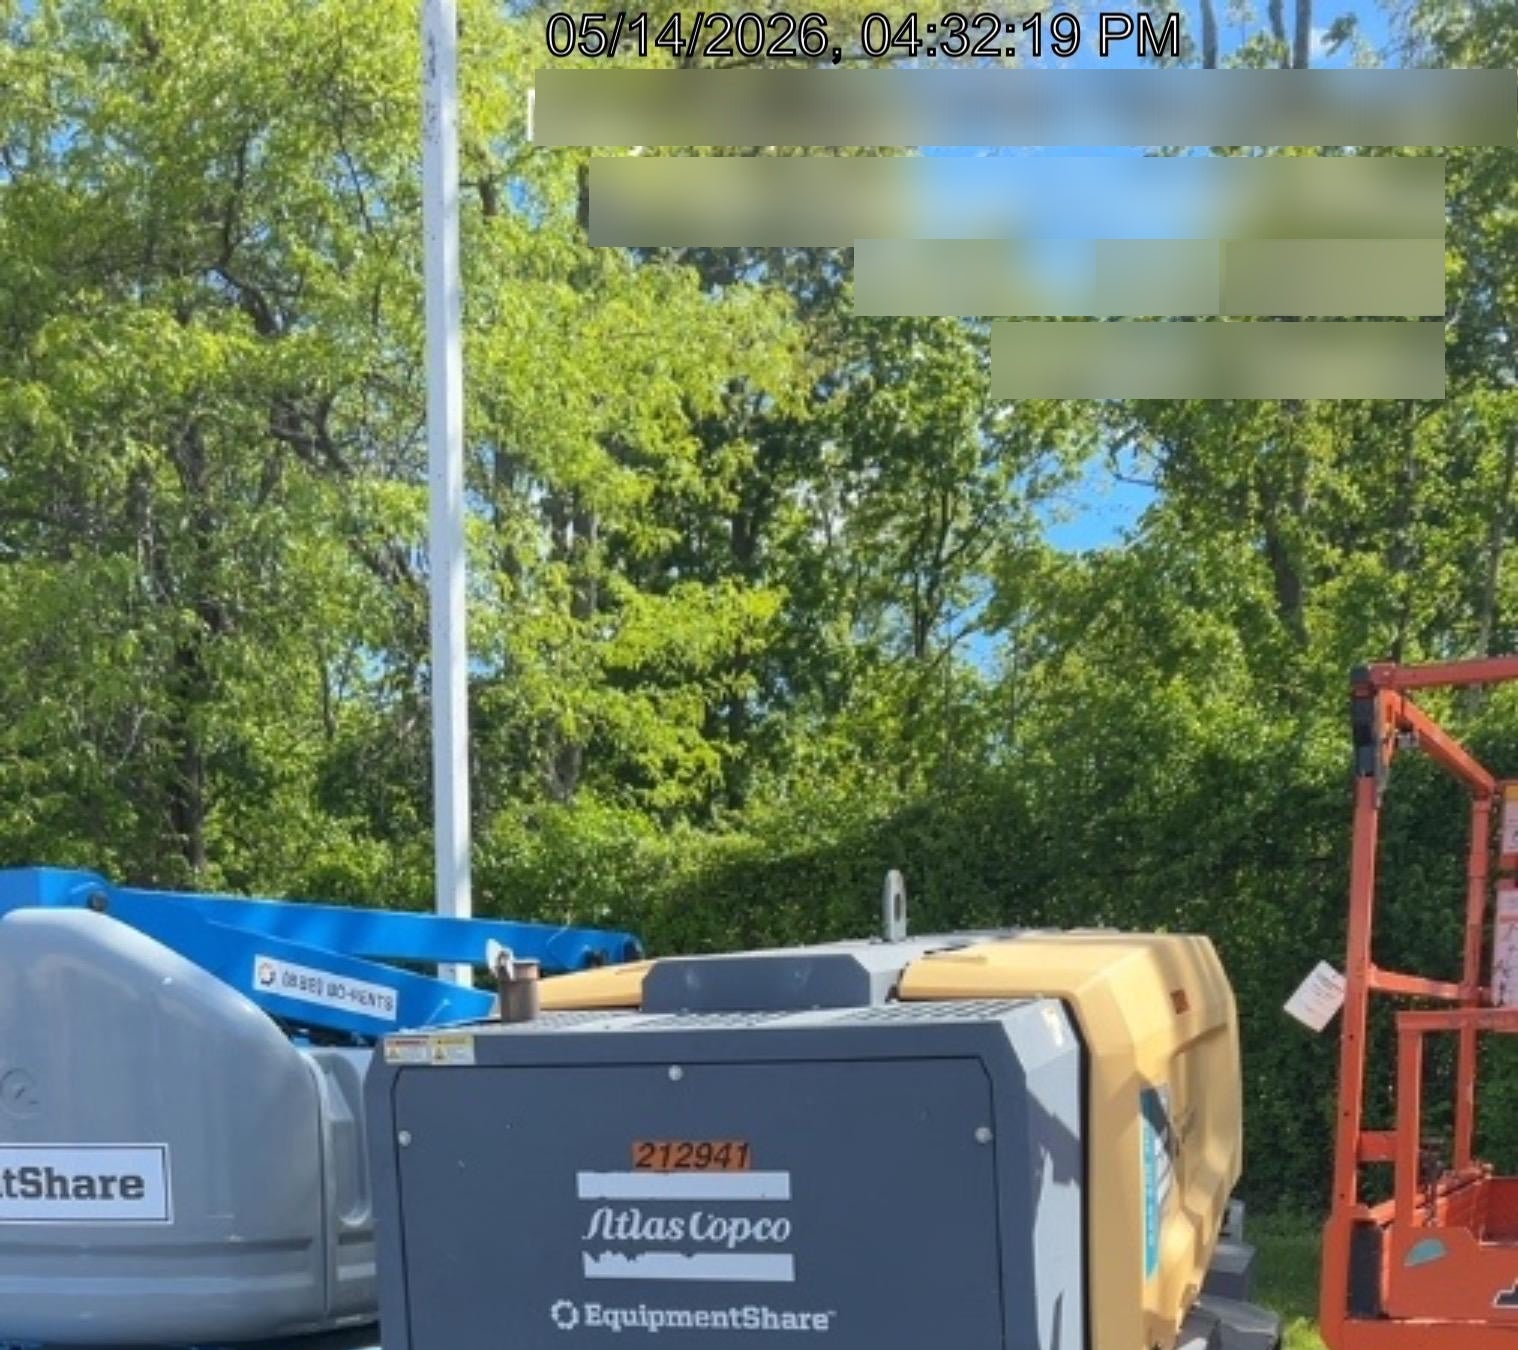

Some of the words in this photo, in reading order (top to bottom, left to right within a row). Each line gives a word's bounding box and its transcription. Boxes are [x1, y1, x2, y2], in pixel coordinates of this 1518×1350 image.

[635, 1142, 749, 1169] 212941
[0, 1166, 145, 1200] tShare
[582, 1206, 685, 1240] Atlas
[689, 1211, 791, 1249] Copco
[584, 1304, 830, 1332] EquipmentShare
